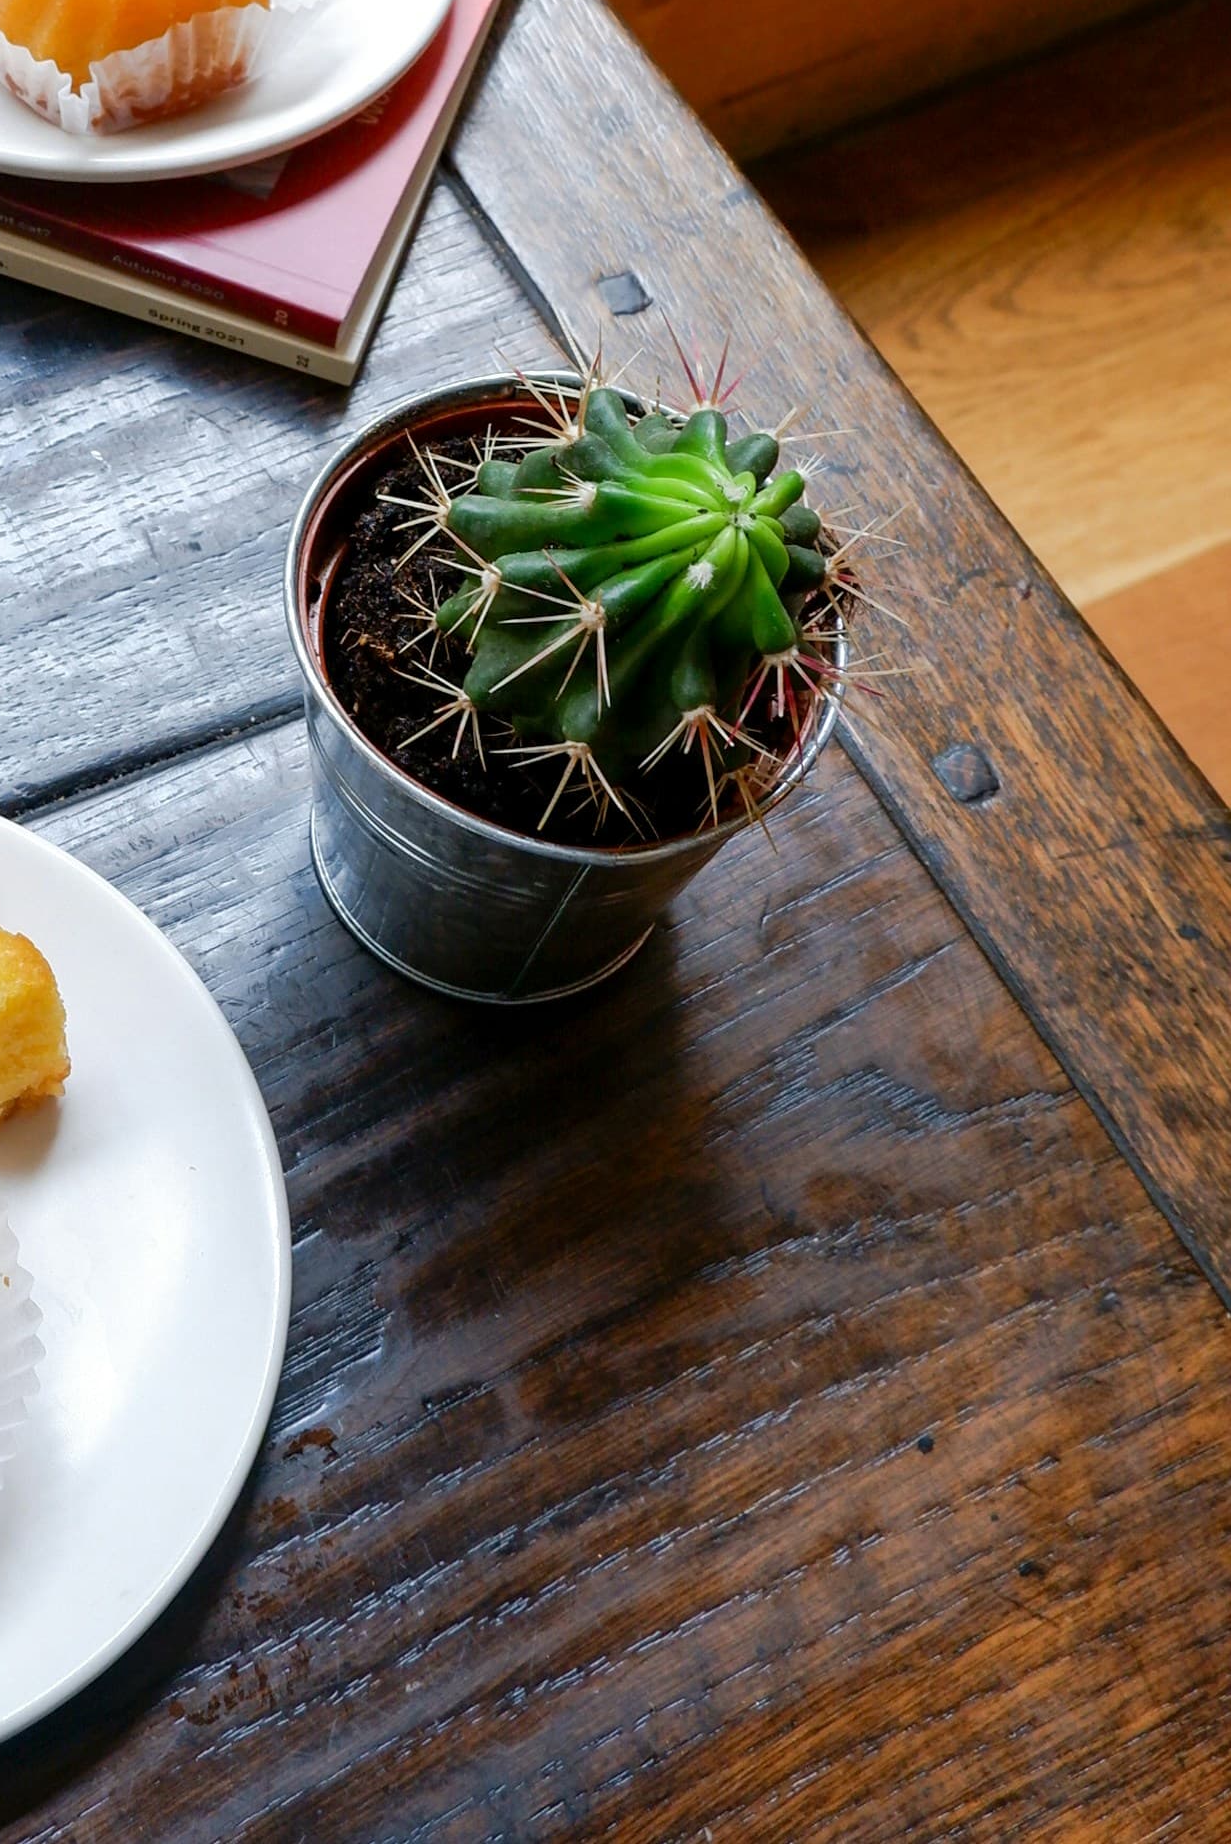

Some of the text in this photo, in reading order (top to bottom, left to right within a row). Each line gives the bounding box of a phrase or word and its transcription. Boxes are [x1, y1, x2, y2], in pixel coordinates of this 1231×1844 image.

[112, 254, 225, 302] Autumn 2020
[147, 308, 246, 347] Spring 2021
